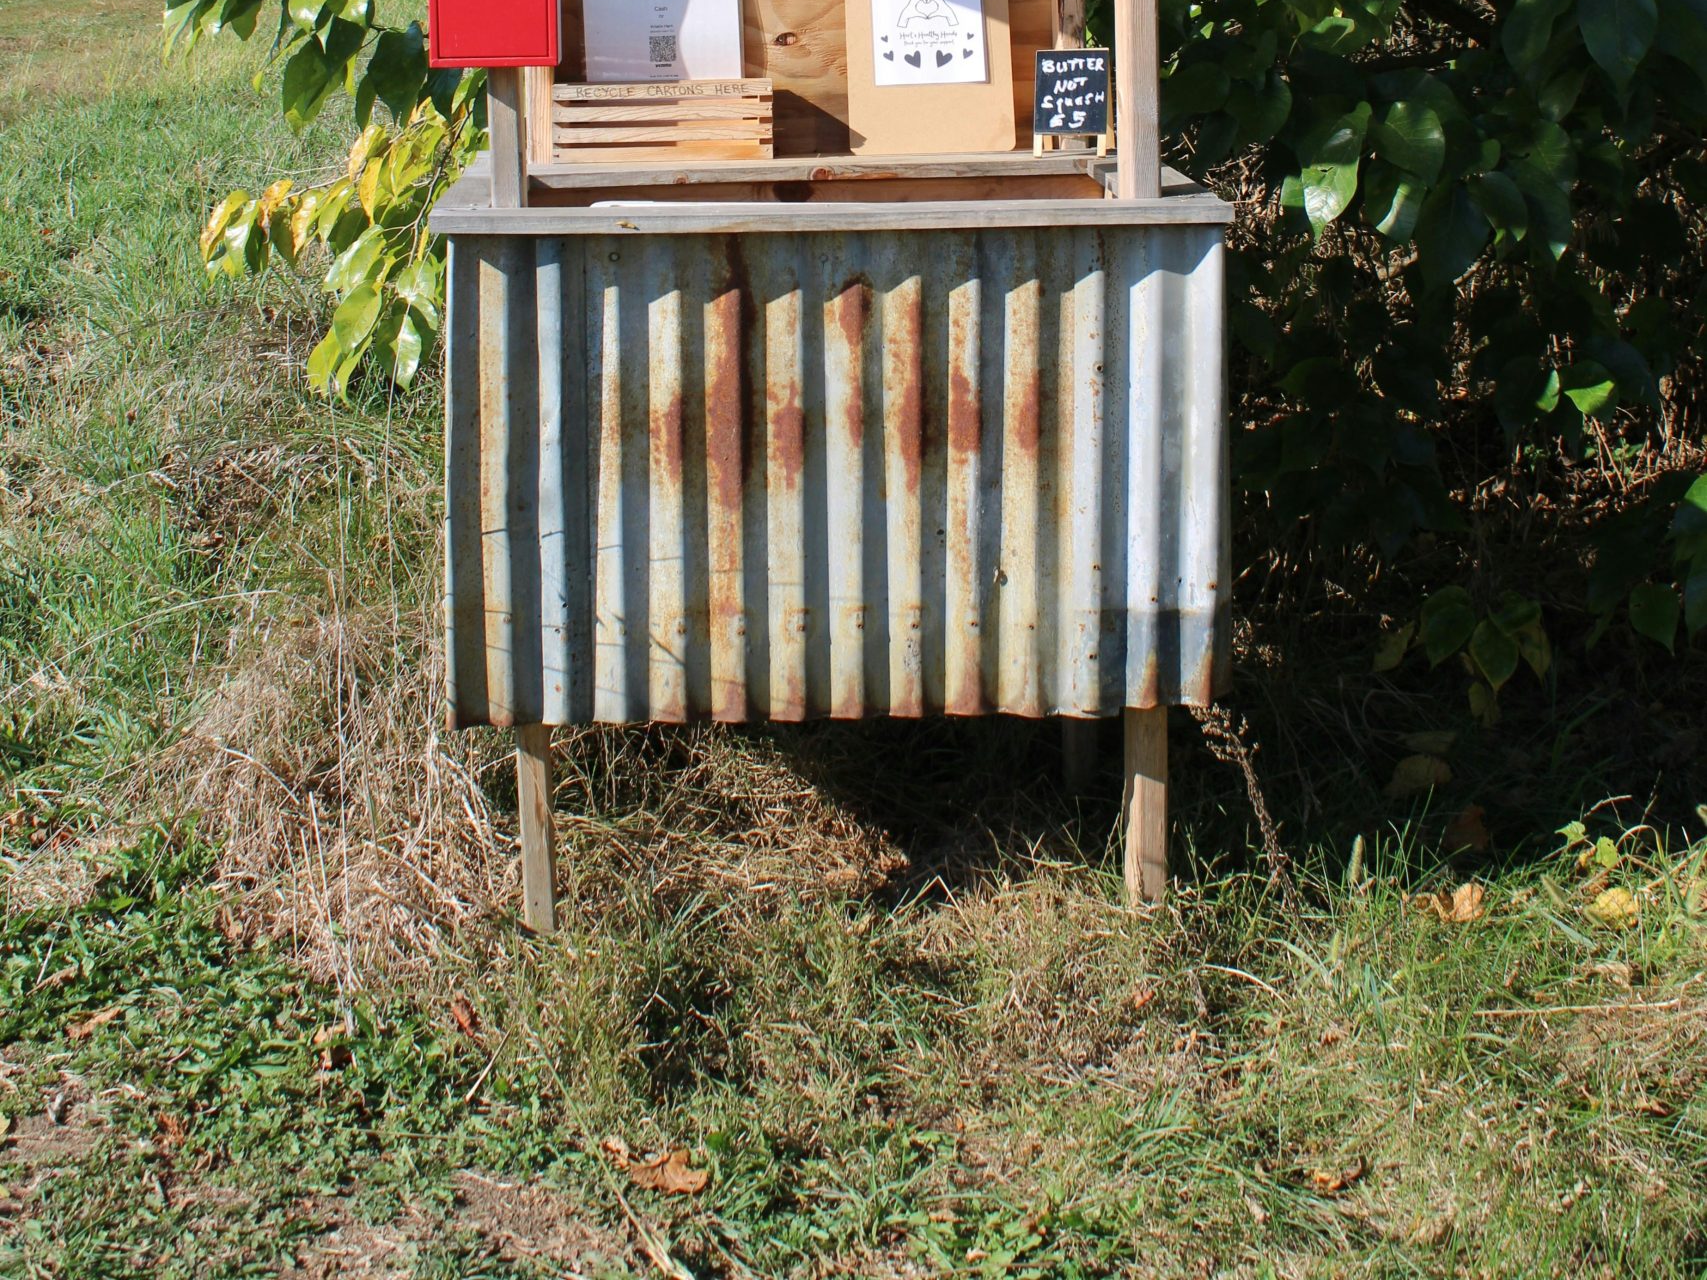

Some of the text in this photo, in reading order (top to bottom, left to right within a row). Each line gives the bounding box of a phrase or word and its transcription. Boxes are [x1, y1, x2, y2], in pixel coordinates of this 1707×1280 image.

[1041, 57, 1105, 74] BUTTER
[575, 83, 750, 99] RECYCLE CARTONS HERE
